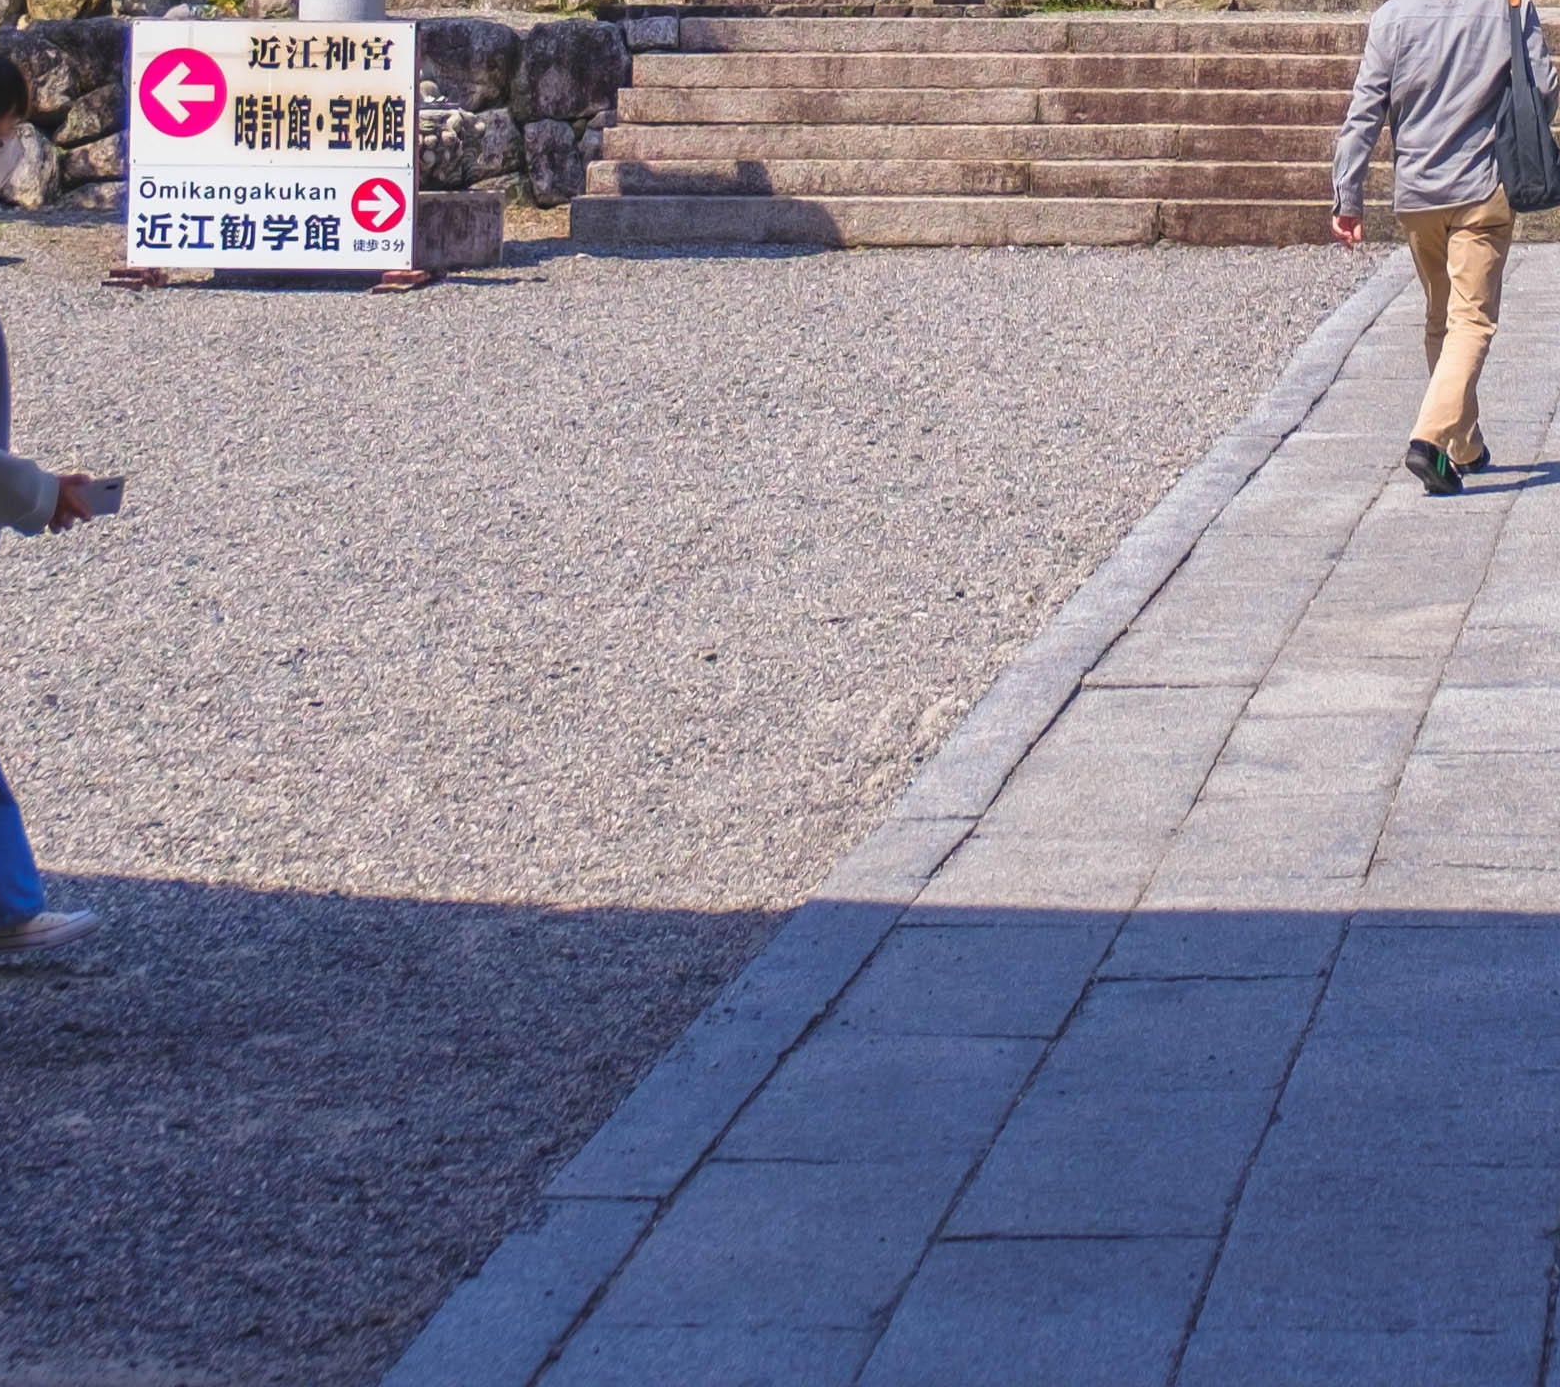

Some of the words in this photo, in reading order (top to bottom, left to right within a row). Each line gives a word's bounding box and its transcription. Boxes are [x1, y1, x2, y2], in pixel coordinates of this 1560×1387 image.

[248, 35, 396, 71] 近江神宮
[234, 94, 406, 151] 時計館・宝物館
[139, 176, 337, 205] Ōmikangakukan
[136, 212, 341, 252] 近江勧学館
[352, 238, 406, 253] 徒歩3分
